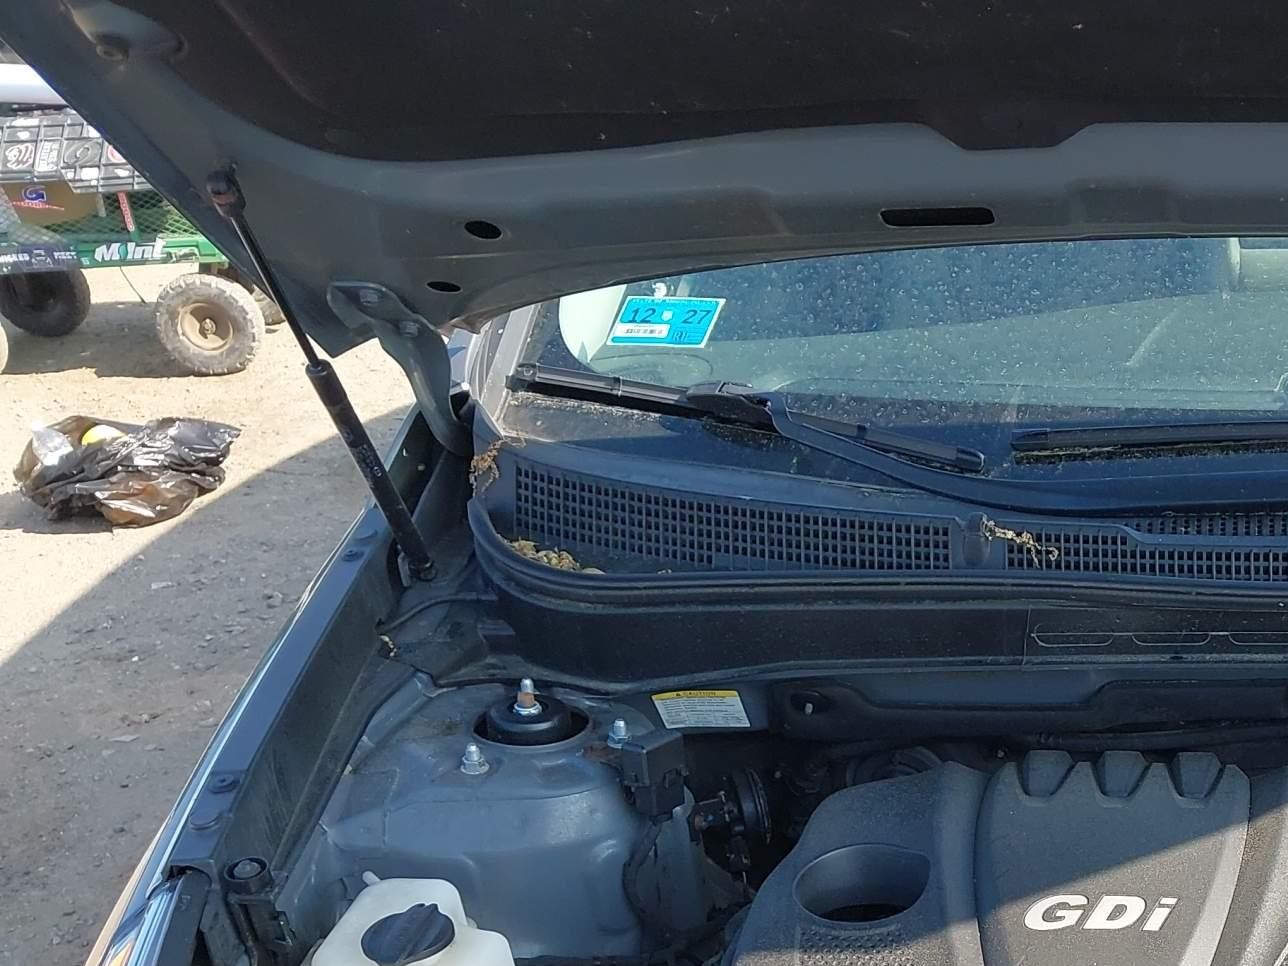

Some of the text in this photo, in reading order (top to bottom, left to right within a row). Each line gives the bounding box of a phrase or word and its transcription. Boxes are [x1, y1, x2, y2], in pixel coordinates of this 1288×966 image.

[626, 307, 713, 325] 12 27
[1023, 894, 1180, 932] GDi
